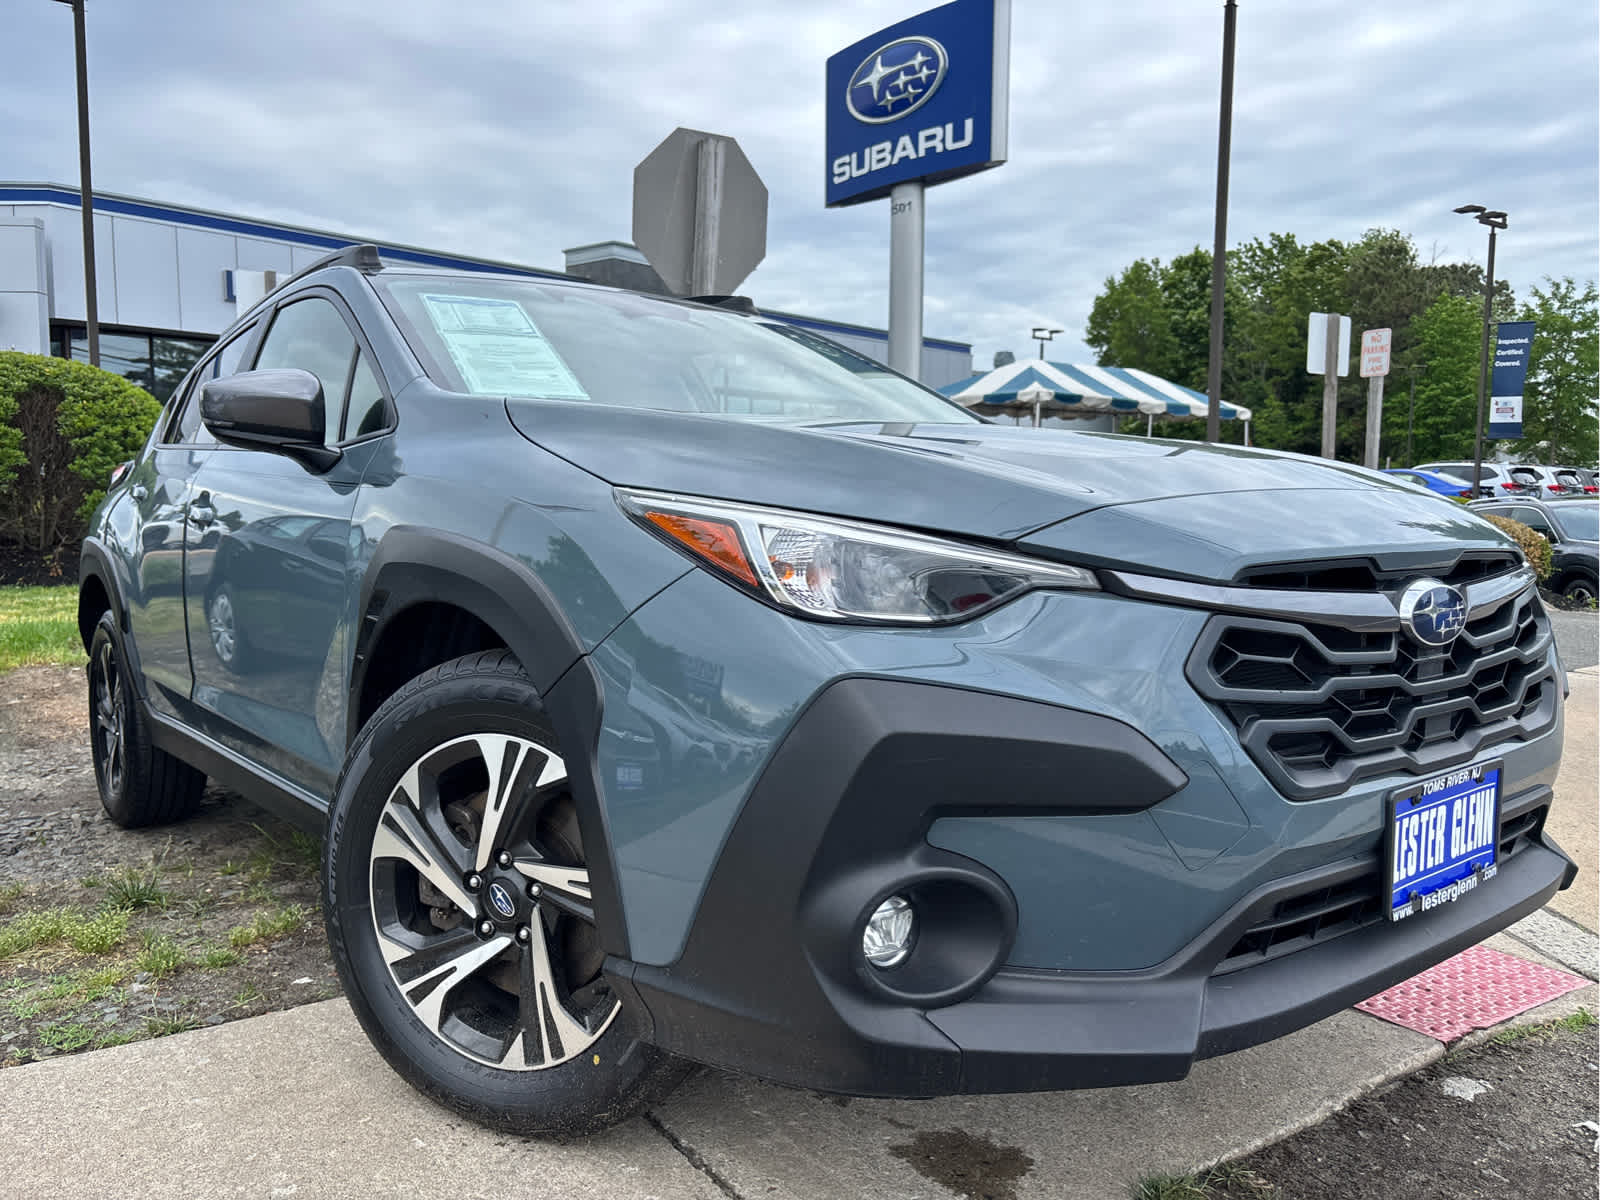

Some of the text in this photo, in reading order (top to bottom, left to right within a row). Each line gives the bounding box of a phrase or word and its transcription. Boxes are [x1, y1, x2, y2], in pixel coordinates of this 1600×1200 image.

[832, 118, 973, 185] SUBARU
[1423, 779, 1446, 796] TOMS
[1471, 766, 1482, 780] NJ
[1393, 787, 1495, 884] LESTER GLENN
